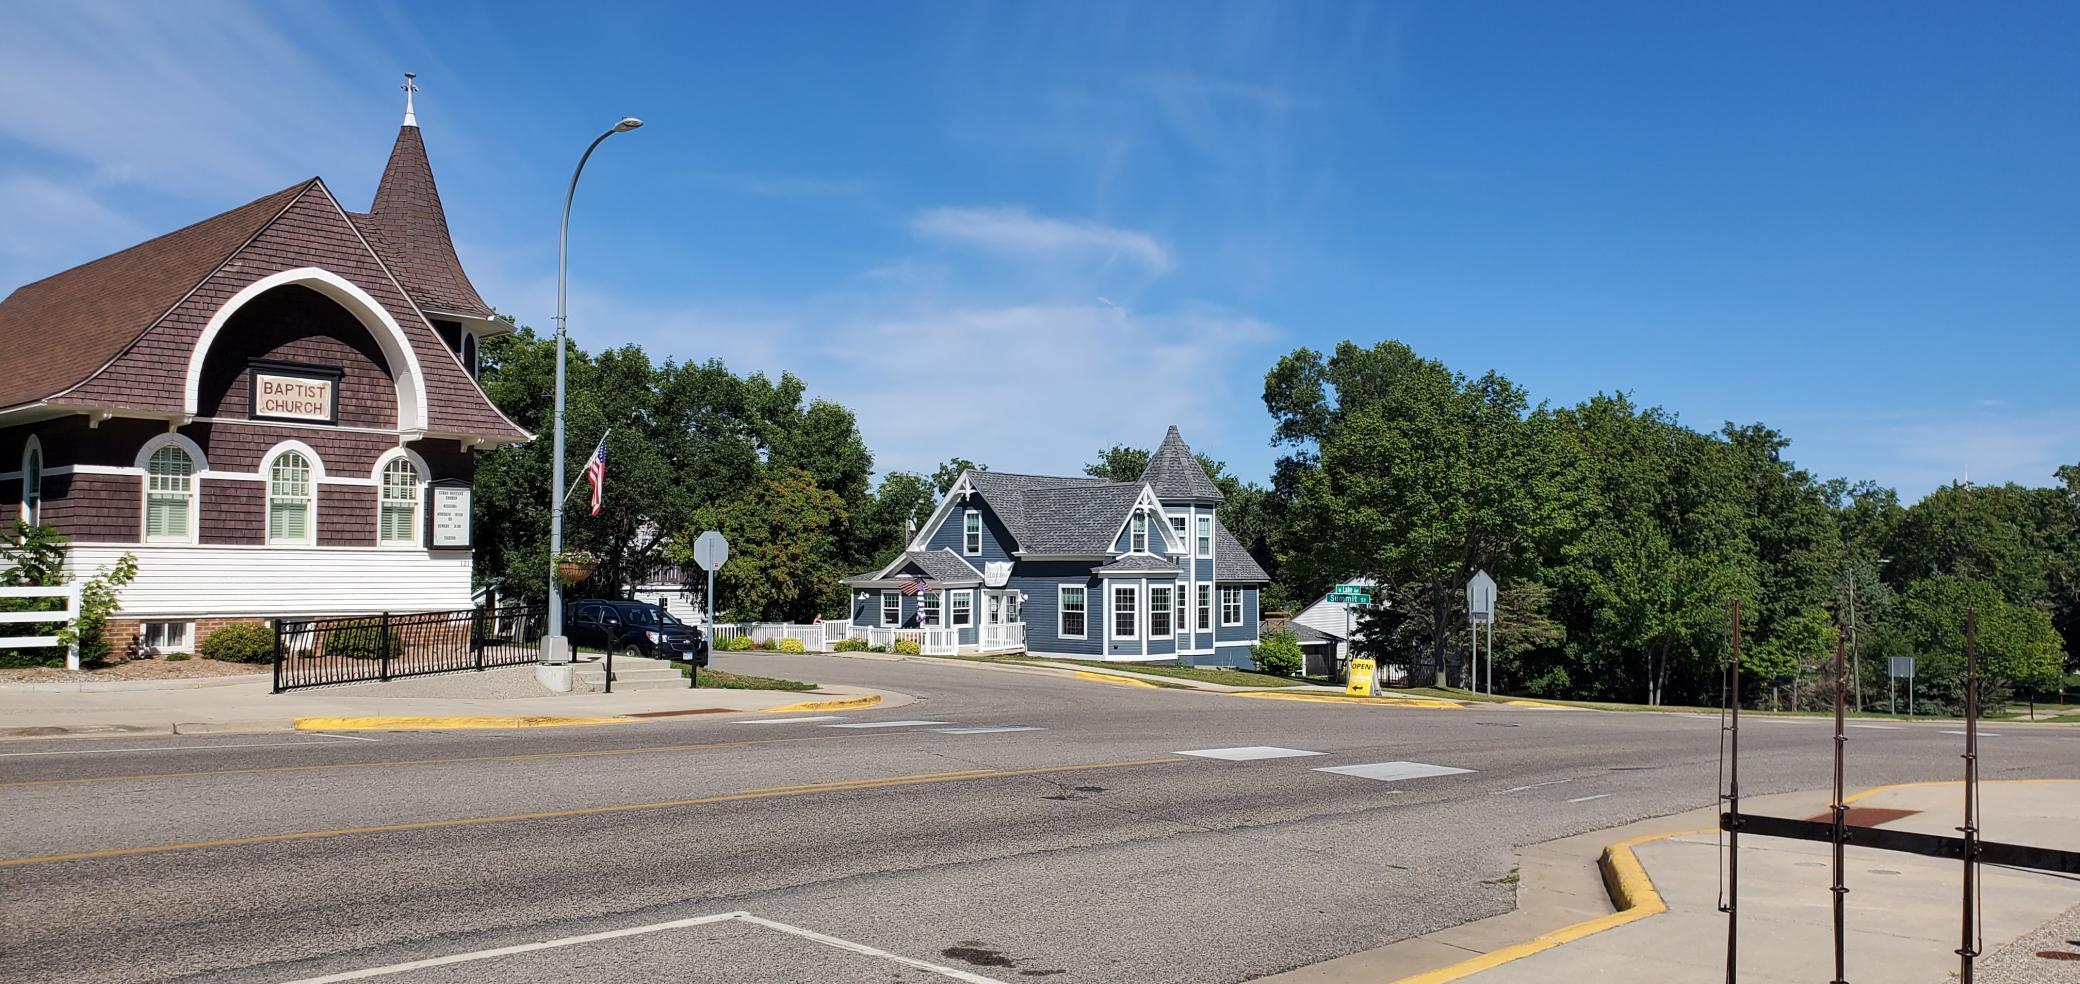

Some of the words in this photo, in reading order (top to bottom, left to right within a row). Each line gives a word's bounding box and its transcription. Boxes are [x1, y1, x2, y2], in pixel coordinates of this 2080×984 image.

[263, 382, 326, 398] BAPTIST
[265, 399, 323, 415] CHURCH
[1342, 585, 1353, 593] Lake
